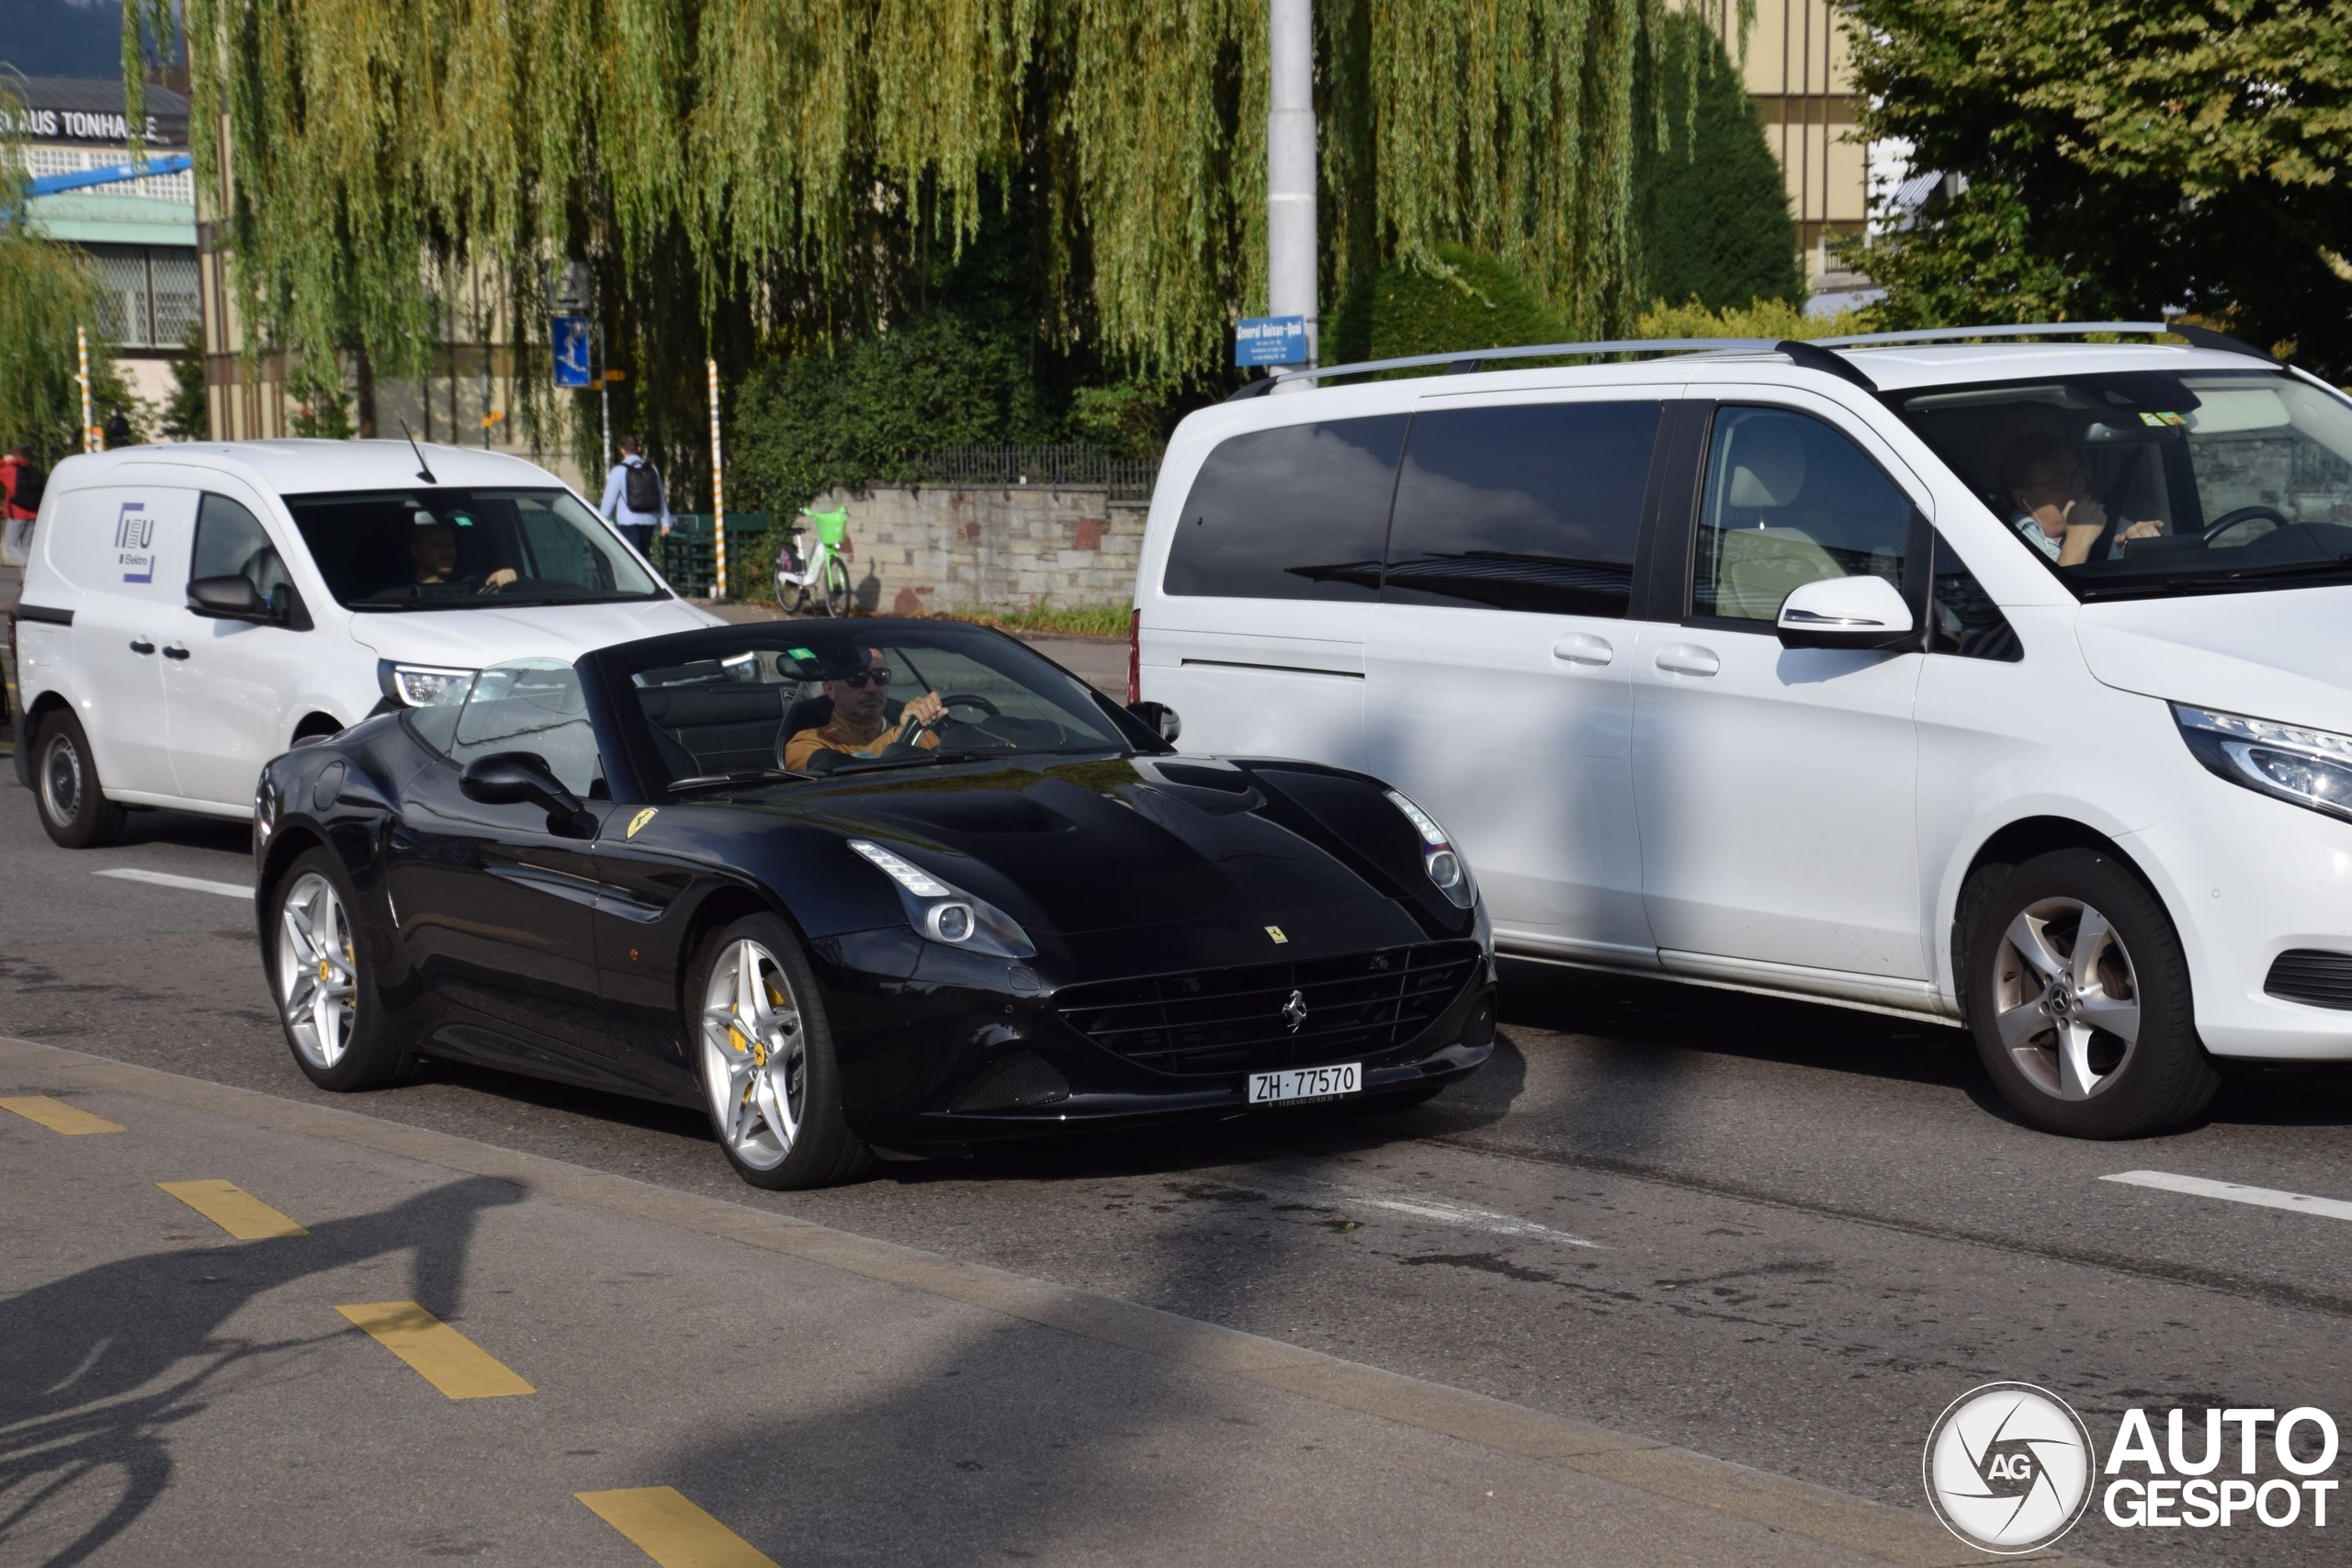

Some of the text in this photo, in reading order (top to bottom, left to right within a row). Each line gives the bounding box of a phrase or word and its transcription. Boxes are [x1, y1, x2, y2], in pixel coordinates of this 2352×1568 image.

[61, 111, 157, 141] TONHAE
[1237, 324, 1261, 341] General
[125, 554, 148, 566] Elektro
[1295, 1066, 1354, 1096] 77570
